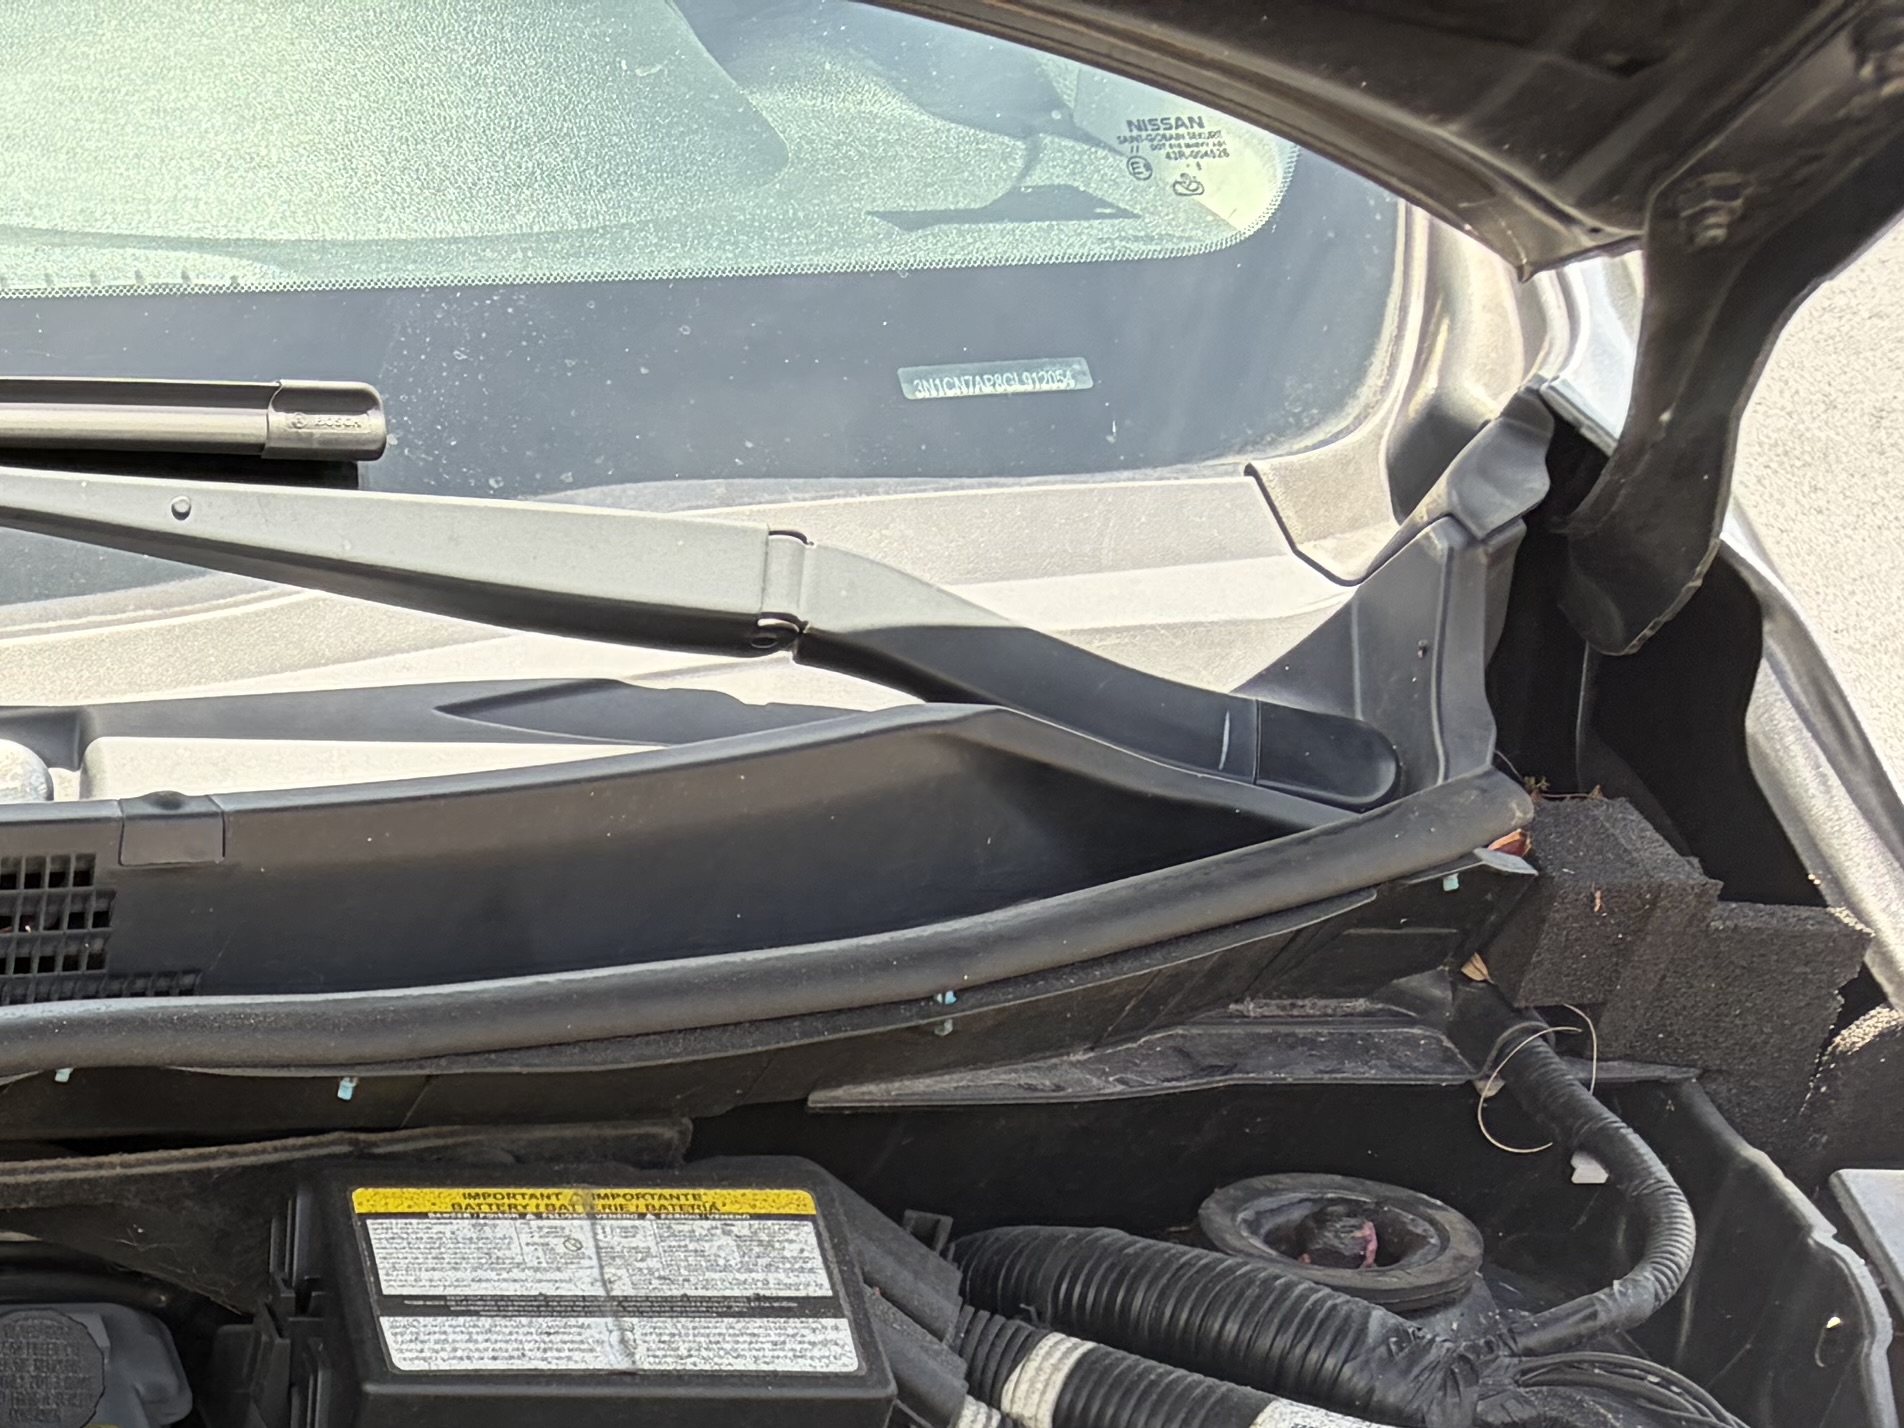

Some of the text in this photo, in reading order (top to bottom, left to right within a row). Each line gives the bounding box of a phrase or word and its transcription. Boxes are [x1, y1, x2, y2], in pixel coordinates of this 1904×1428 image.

[1126, 116, 1205, 132] NISSAN
[913, 370, 1075, 398] 3N1CN7AP8GL912054
[462, 1191, 702, 1202] IMPORTANT IMPORTANTE
[451, 1203, 529, 1212] BATTERY
